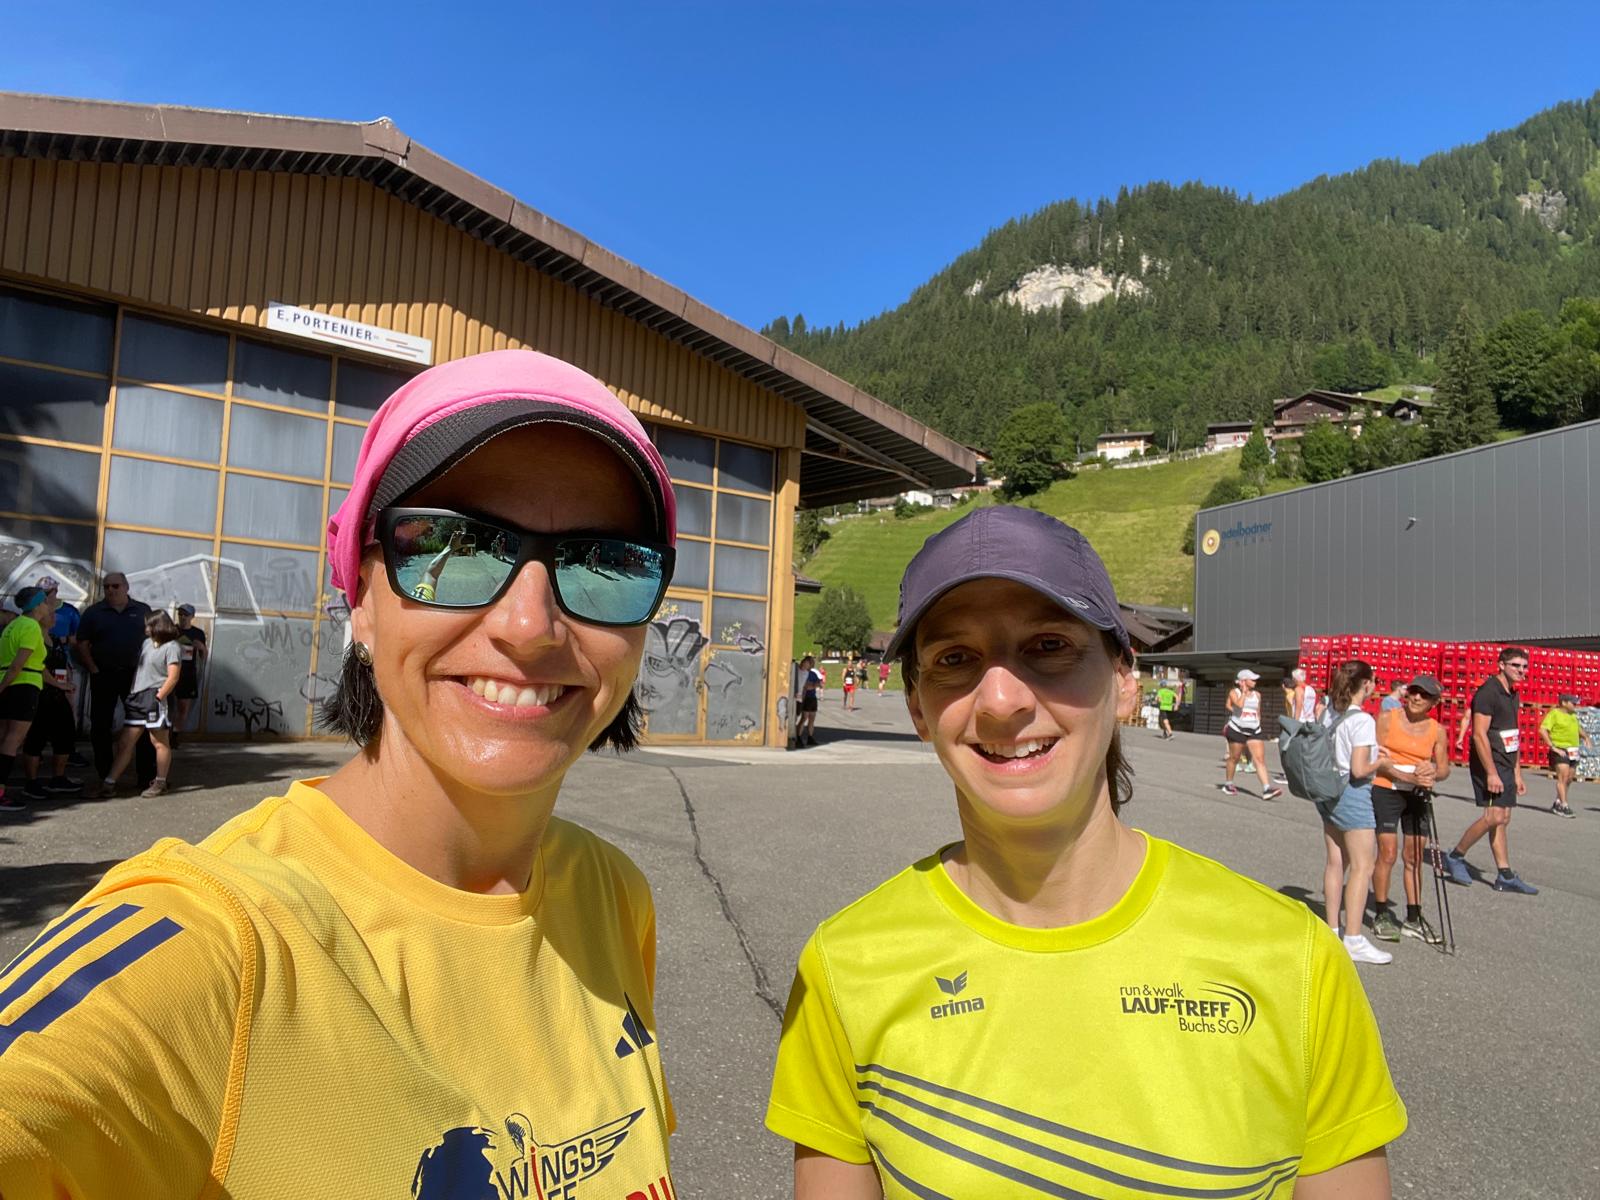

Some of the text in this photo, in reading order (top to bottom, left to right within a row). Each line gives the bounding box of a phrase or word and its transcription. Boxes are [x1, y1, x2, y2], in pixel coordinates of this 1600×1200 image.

[276, 309, 372, 341] E. PORTENIER
[1120, 982, 1185, 998] run & walk
[930, 997, 985, 1019] erima
[1121, 997, 1231, 1018] LAUF-TREFF
[1178, 1017, 1239, 1034] Buchs SG
